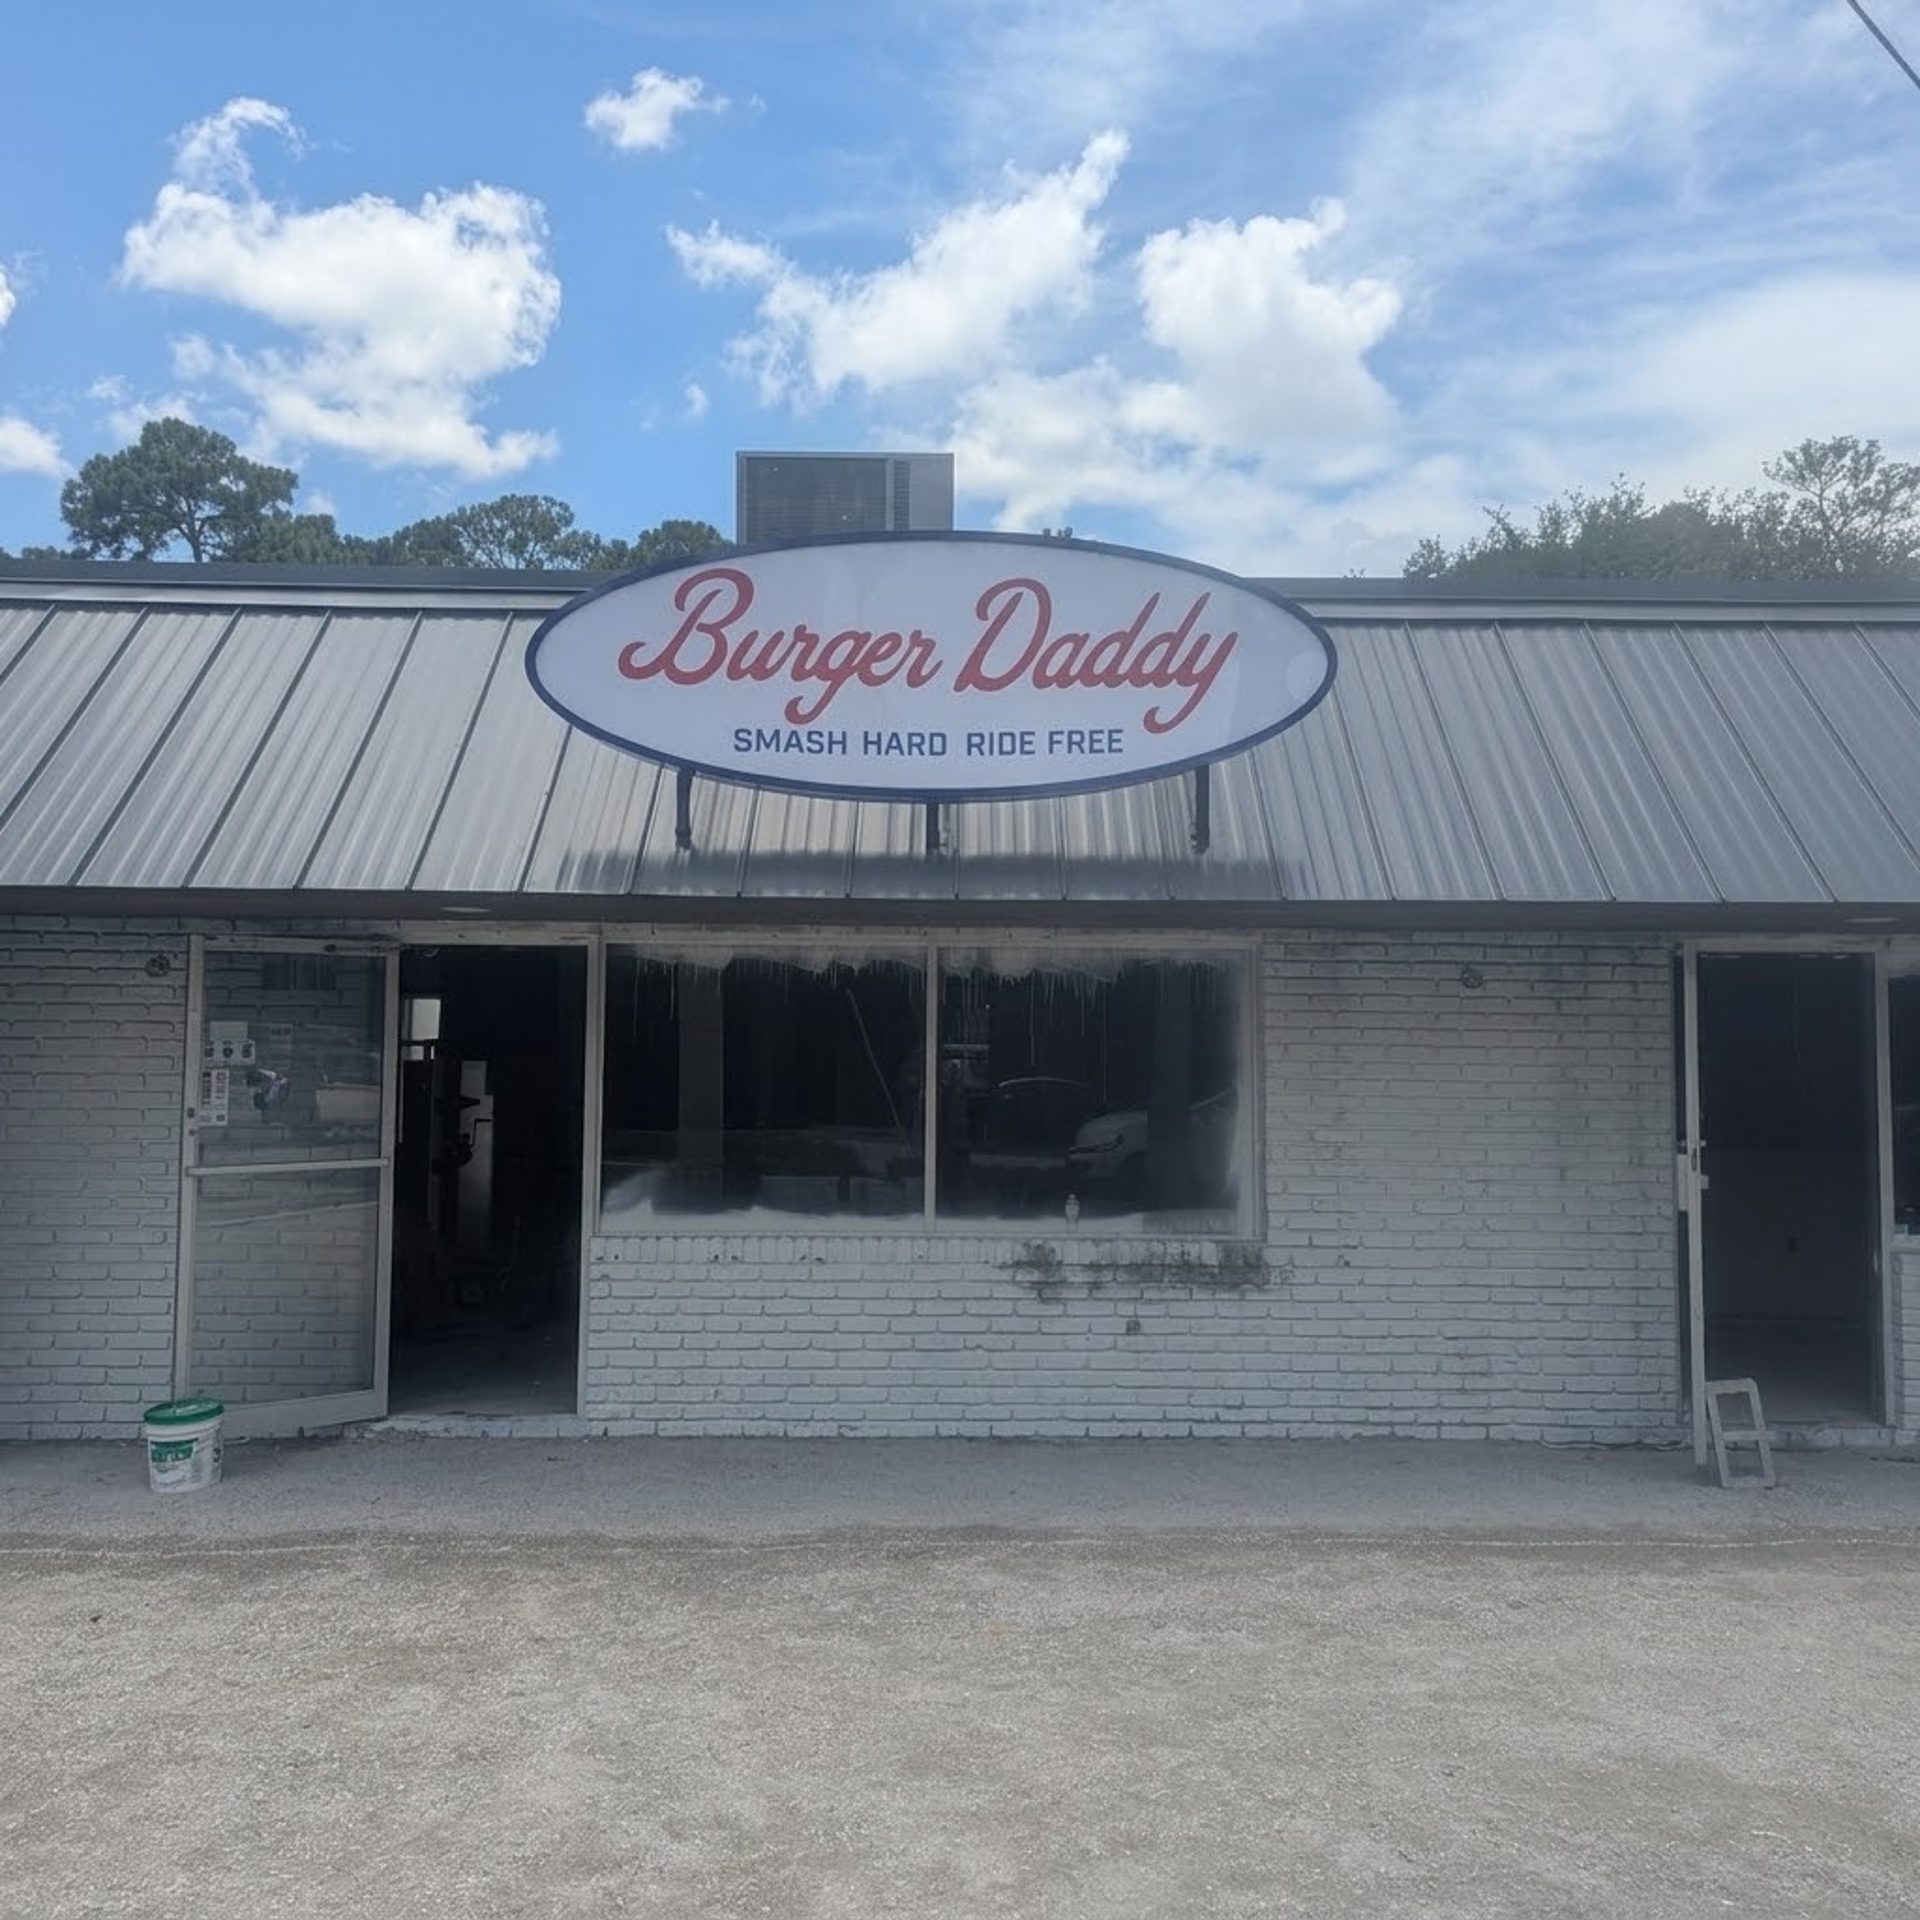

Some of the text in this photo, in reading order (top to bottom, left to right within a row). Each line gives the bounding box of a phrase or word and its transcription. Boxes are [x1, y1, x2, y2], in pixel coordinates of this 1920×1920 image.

[618, 568, 1238, 733] Burger Daddy
[734, 728, 1123, 756] SMASH HARD RIDE FREE
